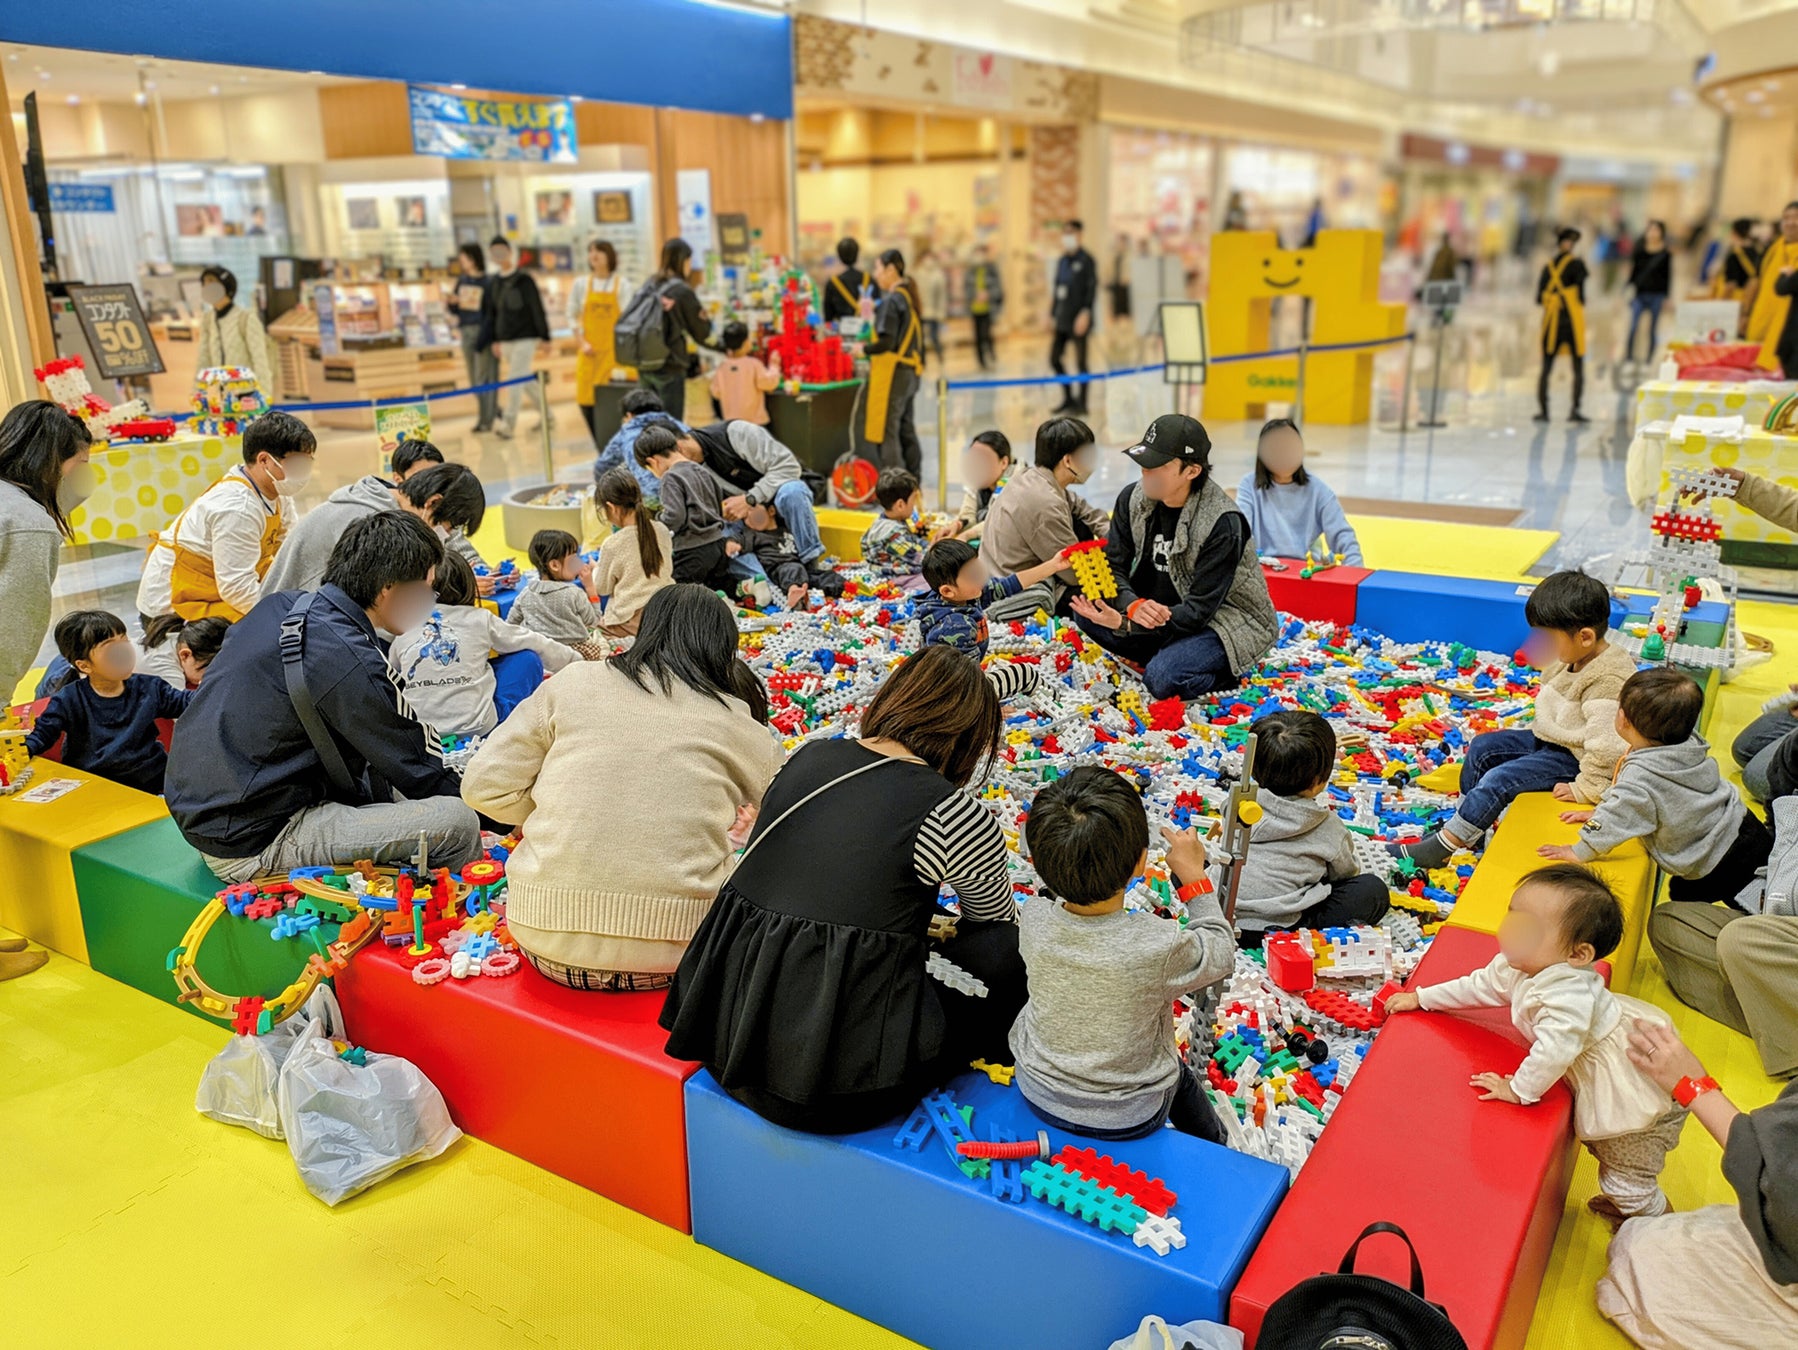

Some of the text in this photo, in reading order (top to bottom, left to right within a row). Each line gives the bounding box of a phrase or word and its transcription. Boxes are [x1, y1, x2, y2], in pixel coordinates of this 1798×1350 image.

[85, 302, 132, 321] コンタクト
[94, 320, 143, 353] 50
[1247, 373, 1298, 388] Gakke
